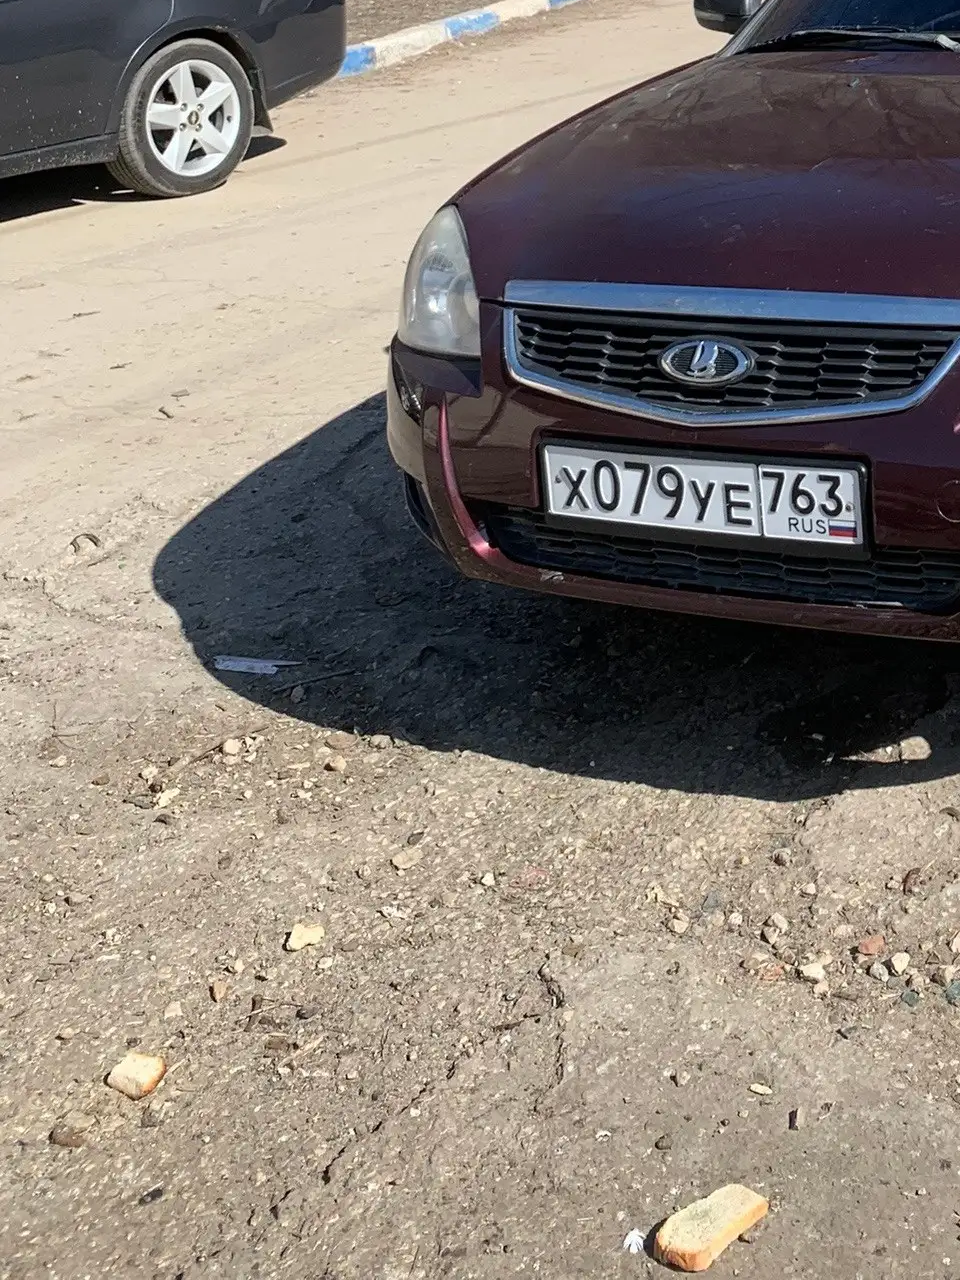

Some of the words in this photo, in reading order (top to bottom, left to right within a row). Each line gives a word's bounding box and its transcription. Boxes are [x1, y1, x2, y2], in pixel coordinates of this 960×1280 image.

[562, 459, 752, 527] Х079УЕ
[762, 471, 843, 517] 763
[788, 517, 826, 535] RUS
